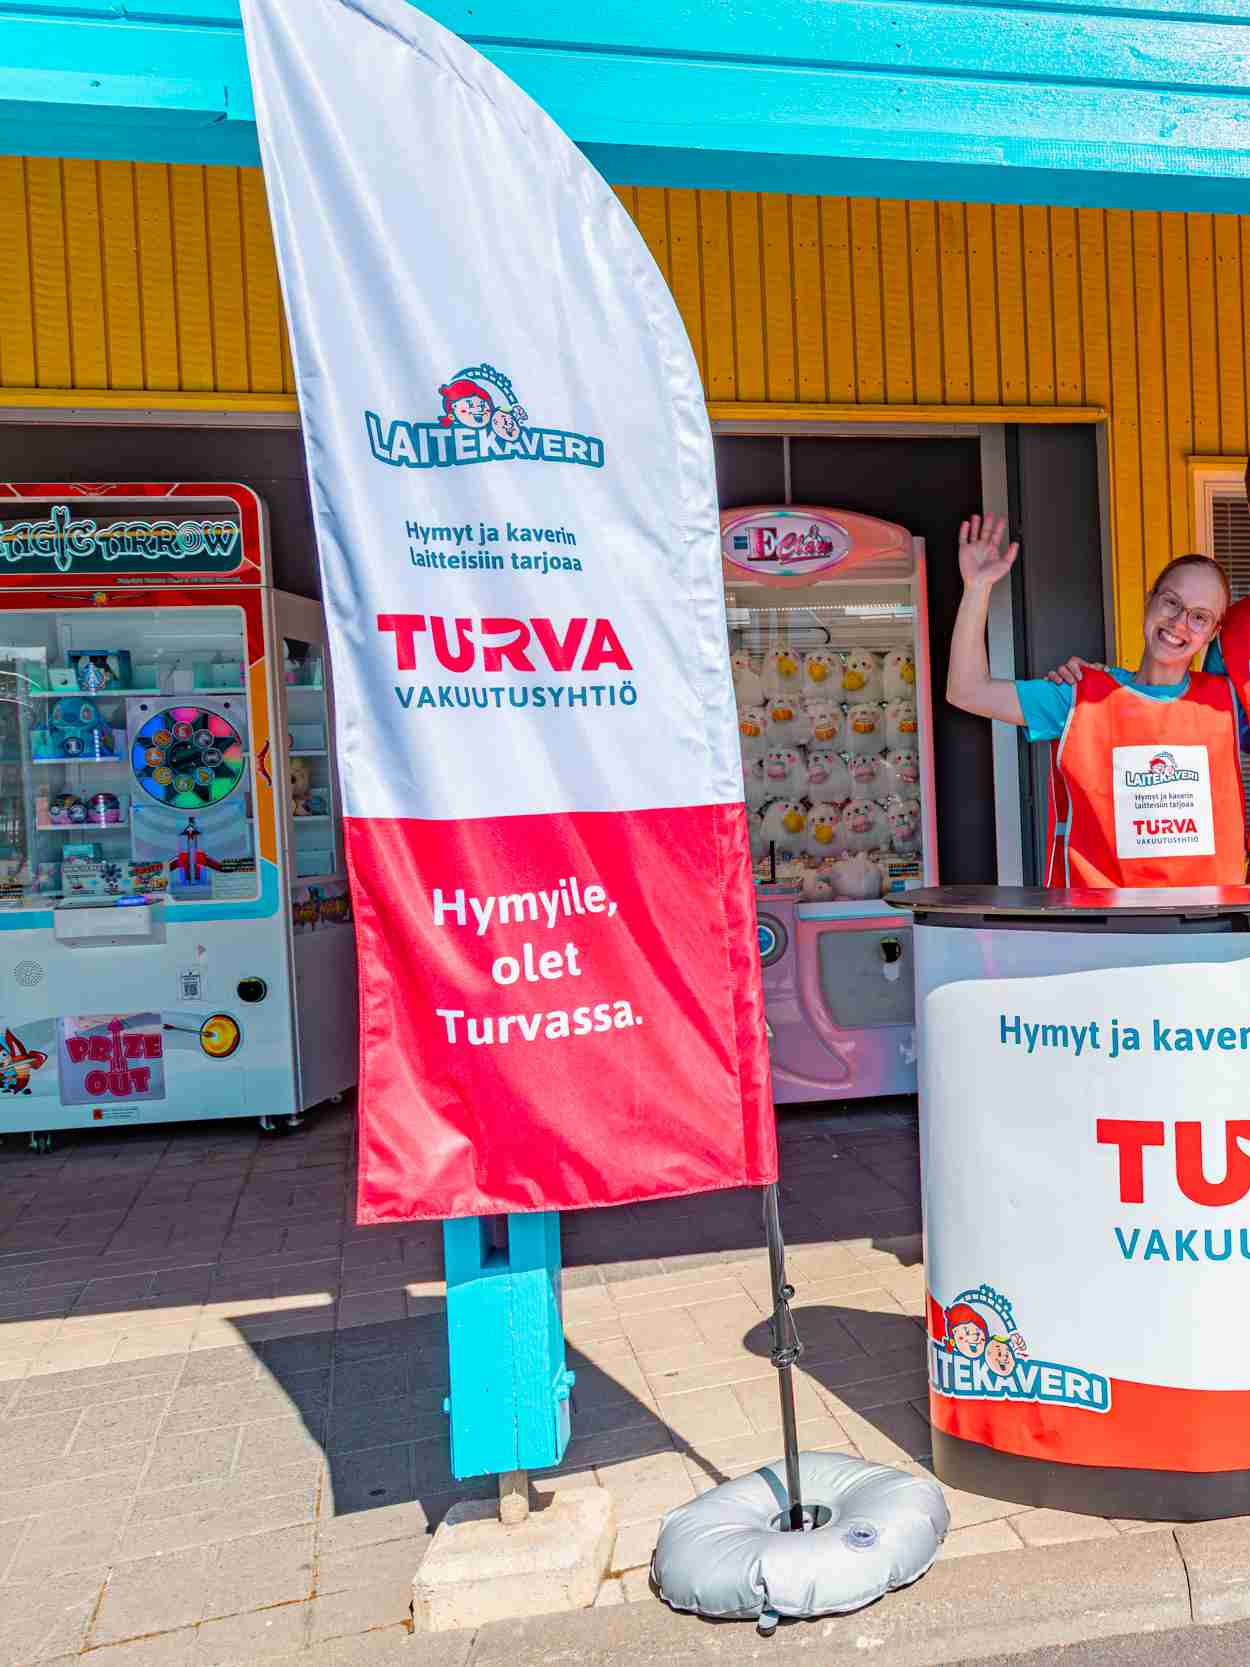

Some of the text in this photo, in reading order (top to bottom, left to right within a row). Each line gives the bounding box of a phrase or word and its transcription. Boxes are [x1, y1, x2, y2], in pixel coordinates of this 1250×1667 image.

[366, 411, 604, 468] LAITEKAVERI
[0, 506, 240, 571] AGIC ARROW
[405, 520, 577, 546] Hymyt ja kaverin
[410, 547, 584, 575] laitteisiin tarjoaa
[377, 614, 634, 673] TURVA
[394, 681, 638, 709] VAKUUTUSYHTIÖ
[1133, 818, 1198, 835] TURVA
[432, 876, 618, 937] Hymyile,
[491, 942, 583, 985] olet
[65, 1022, 163, 1066] PRIZE
[435, 1000, 644, 1046] Turvassa.
[1000, 1015, 1101, 1056] Hymyt
[1109, 1018, 1141, 1058] ja
[85, 1067, 151, 1096] OUT
[930, 1344, 1109, 1410] ITEKAVERI
